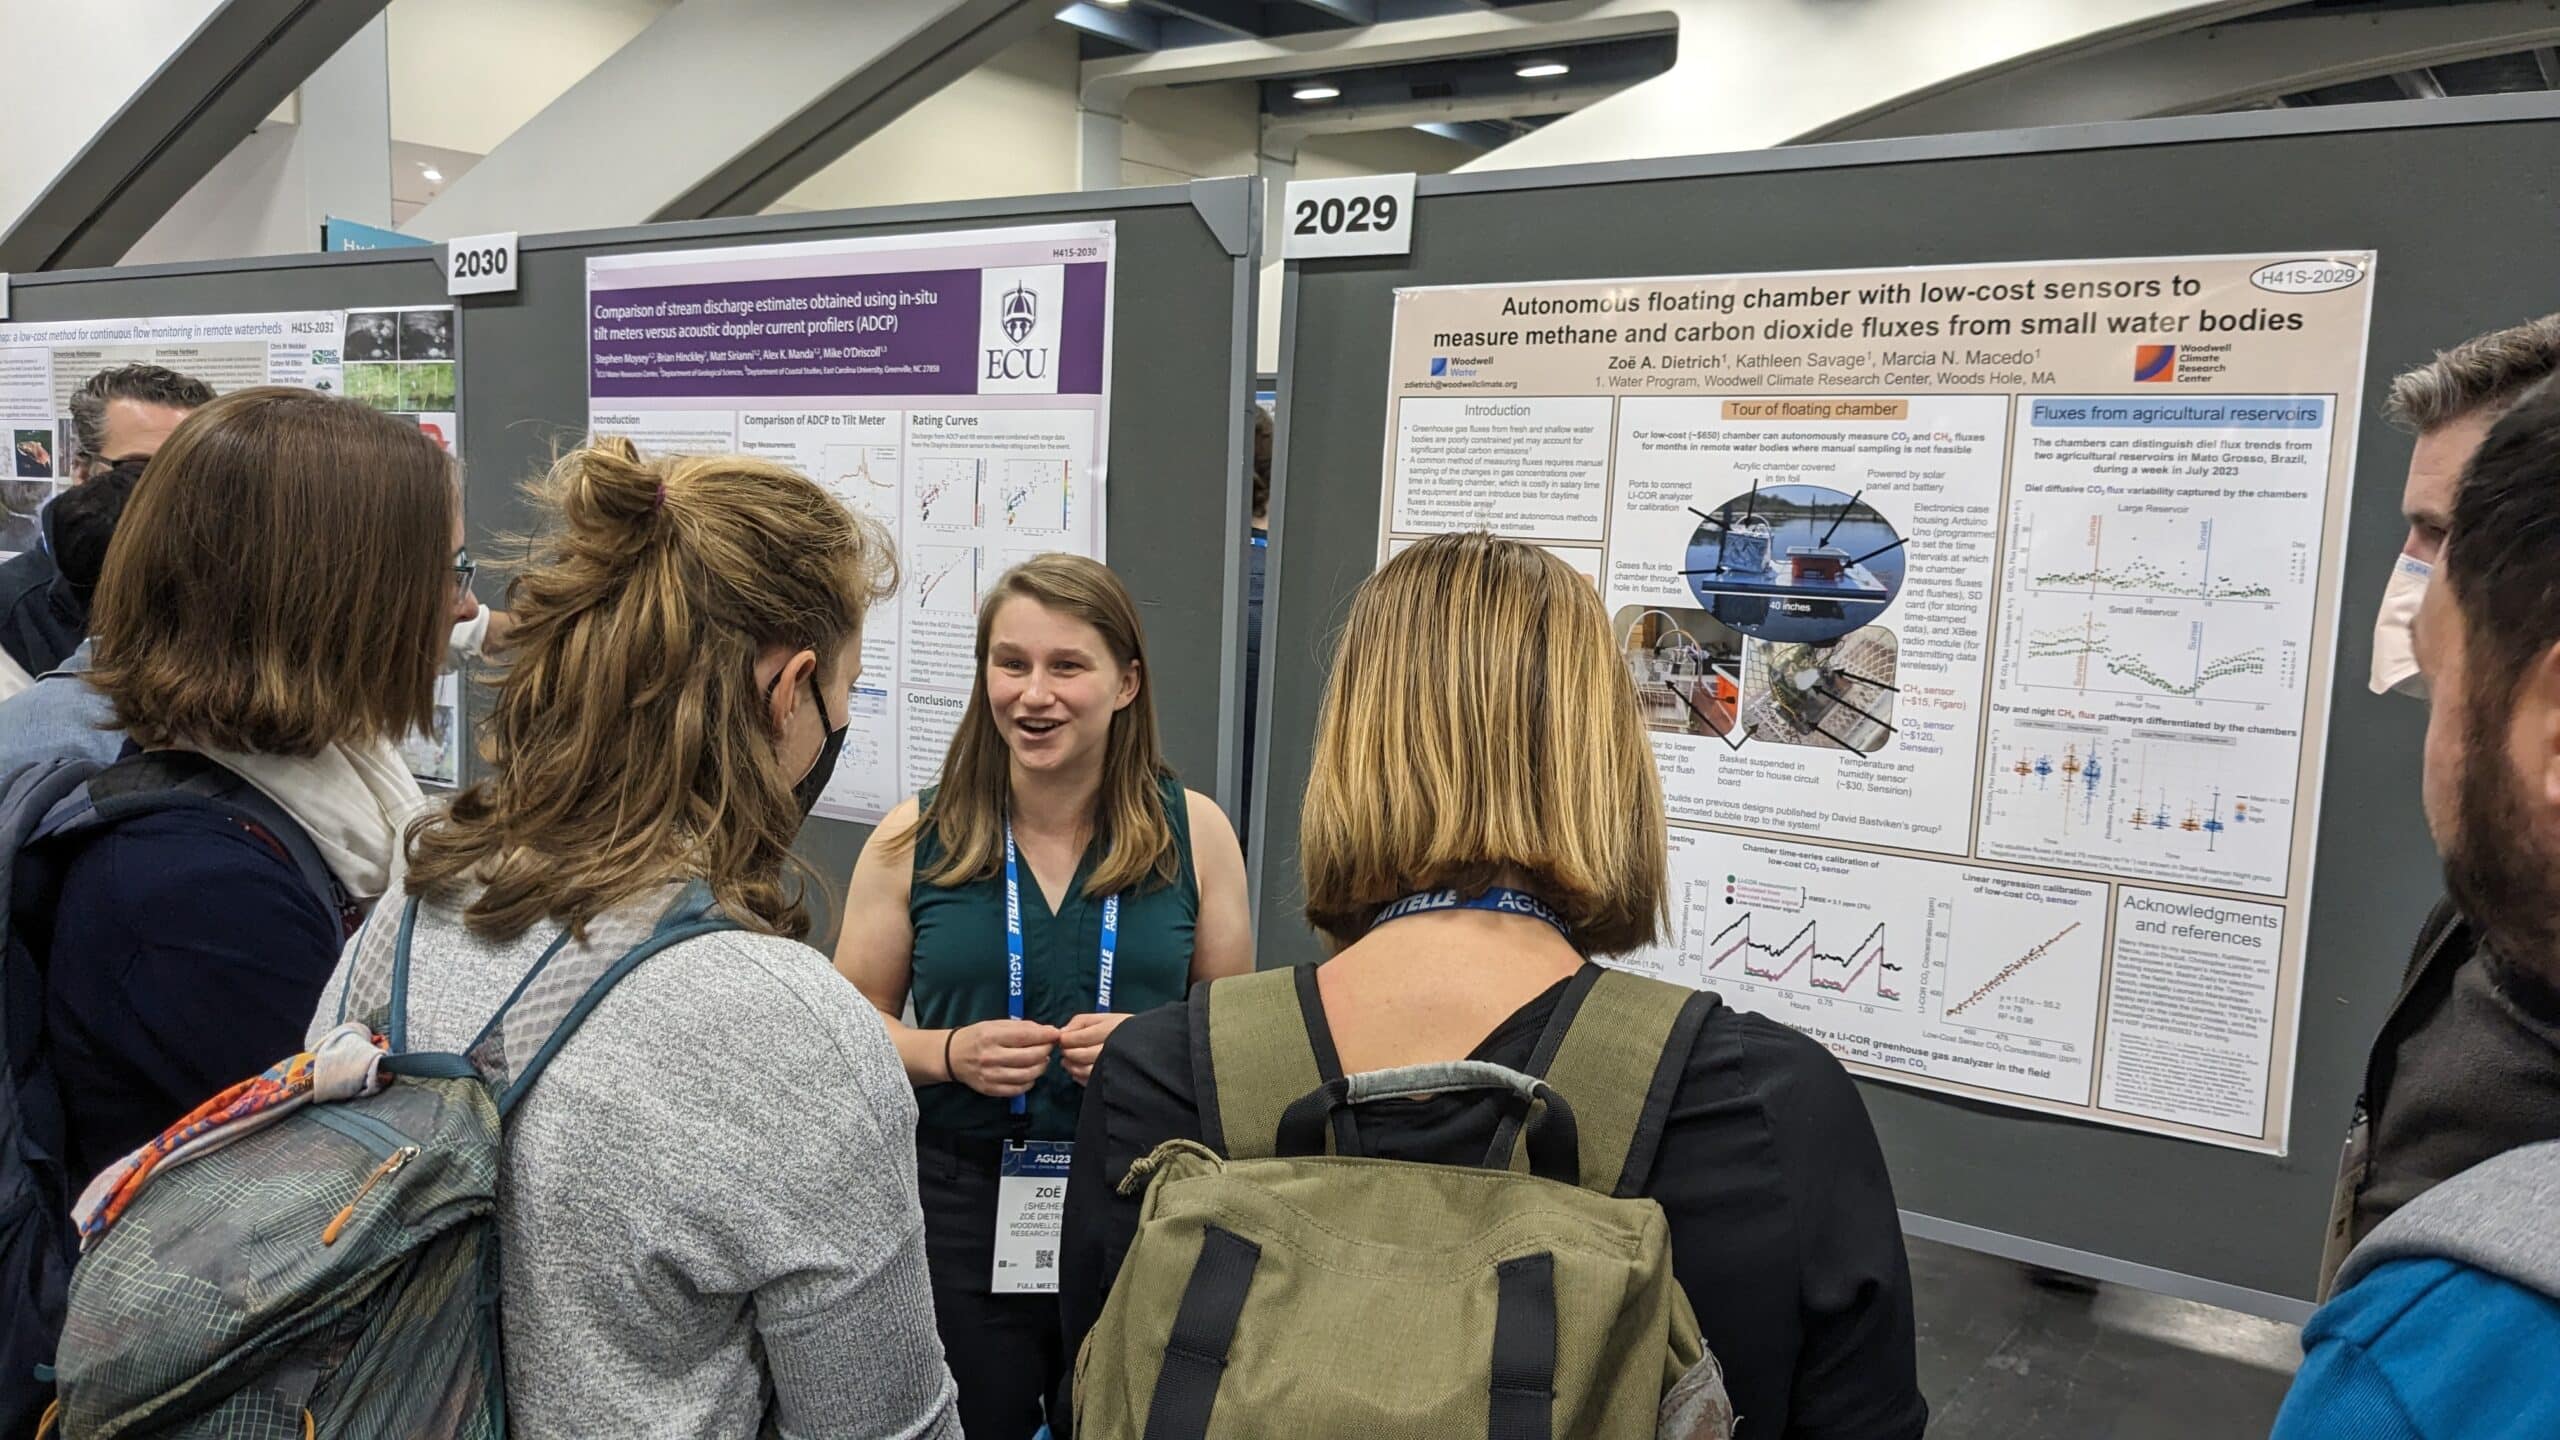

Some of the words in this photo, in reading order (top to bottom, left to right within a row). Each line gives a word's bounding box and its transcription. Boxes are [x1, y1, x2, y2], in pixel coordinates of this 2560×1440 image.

[1293, 195, 1398, 234] 2029
[454, 248, 507, 277] 2030
[2260, 269, 2356, 285] H41S-2029
[1501, 297, 1639, 315] Autonomous
[1647, 291, 1735, 314] floating
[1743, 287, 1851, 308] chamber
[1858, 283, 1910, 304] with
[1920, 280, 2035, 302] low-cost
[2043, 280, 2160, 299] sensors
[2171, 275, 2201, 296] to
[594, 304, 654, 320] Comparison
[654, 301, 667, 316] of
[666, 303, 702, 315] stream
[702, 299, 754, 316] discharge
[755, 297, 808, 311] estimates
[809, 292, 862, 309] obtained
[863, 291, 896, 310] using
[899, 289, 937, 305] in-situ
[13, 334, 17, 342] a
[19, 331, 47, 342] low-cost
[50, 328, 76, 340] method
[78, 327, 88, 339] for
[90, 328, 131, 339] continuous
[133, 326, 149, 338] flow
[152, 324, 192, 340] monitoring
[194, 324, 200, 336] in
[203, 325, 232, 336] remote
[234, 322, 282, 335] watersheds
[291, 322, 334, 334] H41S-2031
[593, 326, 608, 340] tilt
[609, 327, 644, 340] meters
[644, 327, 677, 338] versus
[678, 323, 720, 337] acoustic
[721, 320, 764, 338] doppler
[765, 320, 806, 334] current
[807, 316, 854, 336] profilers
[856, 314, 898, 332] (ADCP)
[1433, 331, 1518, 346] measure
[1525, 325, 1617, 344] methane
[1624, 323, 1667, 342] and
[1674, 322, 1754, 341] carbon
[1763, 318, 1853, 339] dioxide
[1861, 316, 1939, 337] fluxes
[1948, 314, 2010, 335] from
[2020, 312, 2096, 334] small
[2106, 312, 2190, 333] water
[2198, 308, 2303, 331] bodies
[2180, 343, 2231, 352] Woodwell
[985, 348, 1048, 379] ECU
[1450, 356, 1494, 365] Woodwell
[1607, 355, 1636, 369] Zoë
[1640, 355, 1656, 369] A.
[1736, 354, 1802, 367] Kathleen
[1882, 351, 1936, 365] Marcia
[1941, 350, 1959, 364] N.
[2178, 354, 2220, 362] Climate
[1450, 367, 1480, 376] Water
[2178, 364, 2226, 372] Research
[1596, 376, 1604, 387] 1.
[1608, 375, 1643, 387] Water
[1646, 375, 1700, 389] Program,
[1704, 374, 1763, 386] Woodwell
[1766, 373, 1814, 386] Climate
[1817, 373, 1880, 385] Research
[1883, 372, 1932, 385] Center,
[1936, 372, 1985, 384] Woods
[1989, 371, 2026, 384] Hole,
[2031, 371, 2056, 384] MA
[2176, 374, 2212, 382] Center
[1464, 404, 1530, 416] Introduction
[1730, 402, 1762, 415] Tour
[1764, 402, 1779, 415] of
[1781, 402, 1832, 418] floating
[1834, 402, 1898, 415] chamber
[2033, 405, 2086, 419] Fluxes
[2090, 406, 2127, 420] from
[2132, 406, 2225, 423] agricultural
[2229, 407, 2317, 420] reservoirs
[592, 414, 640, 424] Introduction
[744, 414, 794, 427] Comparison
[796, 414, 806, 425] of
[806, 414, 829, 425] ADCP
[831, 416, 840, 425] to
[841, 414, 856, 425] Tilt
[858, 414, 886, 425] Meter
[912, 414, 943, 428] Rating
[944, 414, 978, 425] Curves
[1866, 468, 1907, 478] Powered
[1908, 470, 1920, 480] by
[1922, 470, 1946, 479] solar
[1769, 600, 1781, 609] 40
[1782, 599, 1811, 611] inches
[907, 692, 963, 709] Conclusions
[1742, 843, 1779, 856] Chamber
[1780, 847, 1823, 861] time-series
[1825, 852, 1868, 867] calibration
[1869, 860, 1880, 869] of
[1006, 879, 1020, 935] BATTELLE
[2123, 896, 2278, 928] Acknowledgments
[2135, 920, 2166, 934] and
[2171, 924, 2261, 947] references
[1009, 953, 1022, 996] AGU23
[1099, 949, 1114, 1007] BATTELLE
[1816, 1028, 1826, 1038] by
[1837, 1032, 1870, 1045] LI-COR
[1873, 1039, 1930, 1058] greenhouse
[1930, 1051, 1949, 1060] gas
[1951, 1055, 1994, 1068] analyzer
[1996, 1061, 2006, 1070] in
[2008, 1064, 2025, 1074] the
[2027, 1067, 2050, 1078] field
[1035, 1154, 1071, 1164] AGU23
[1036, 1185, 1061, 1198] ZOË
